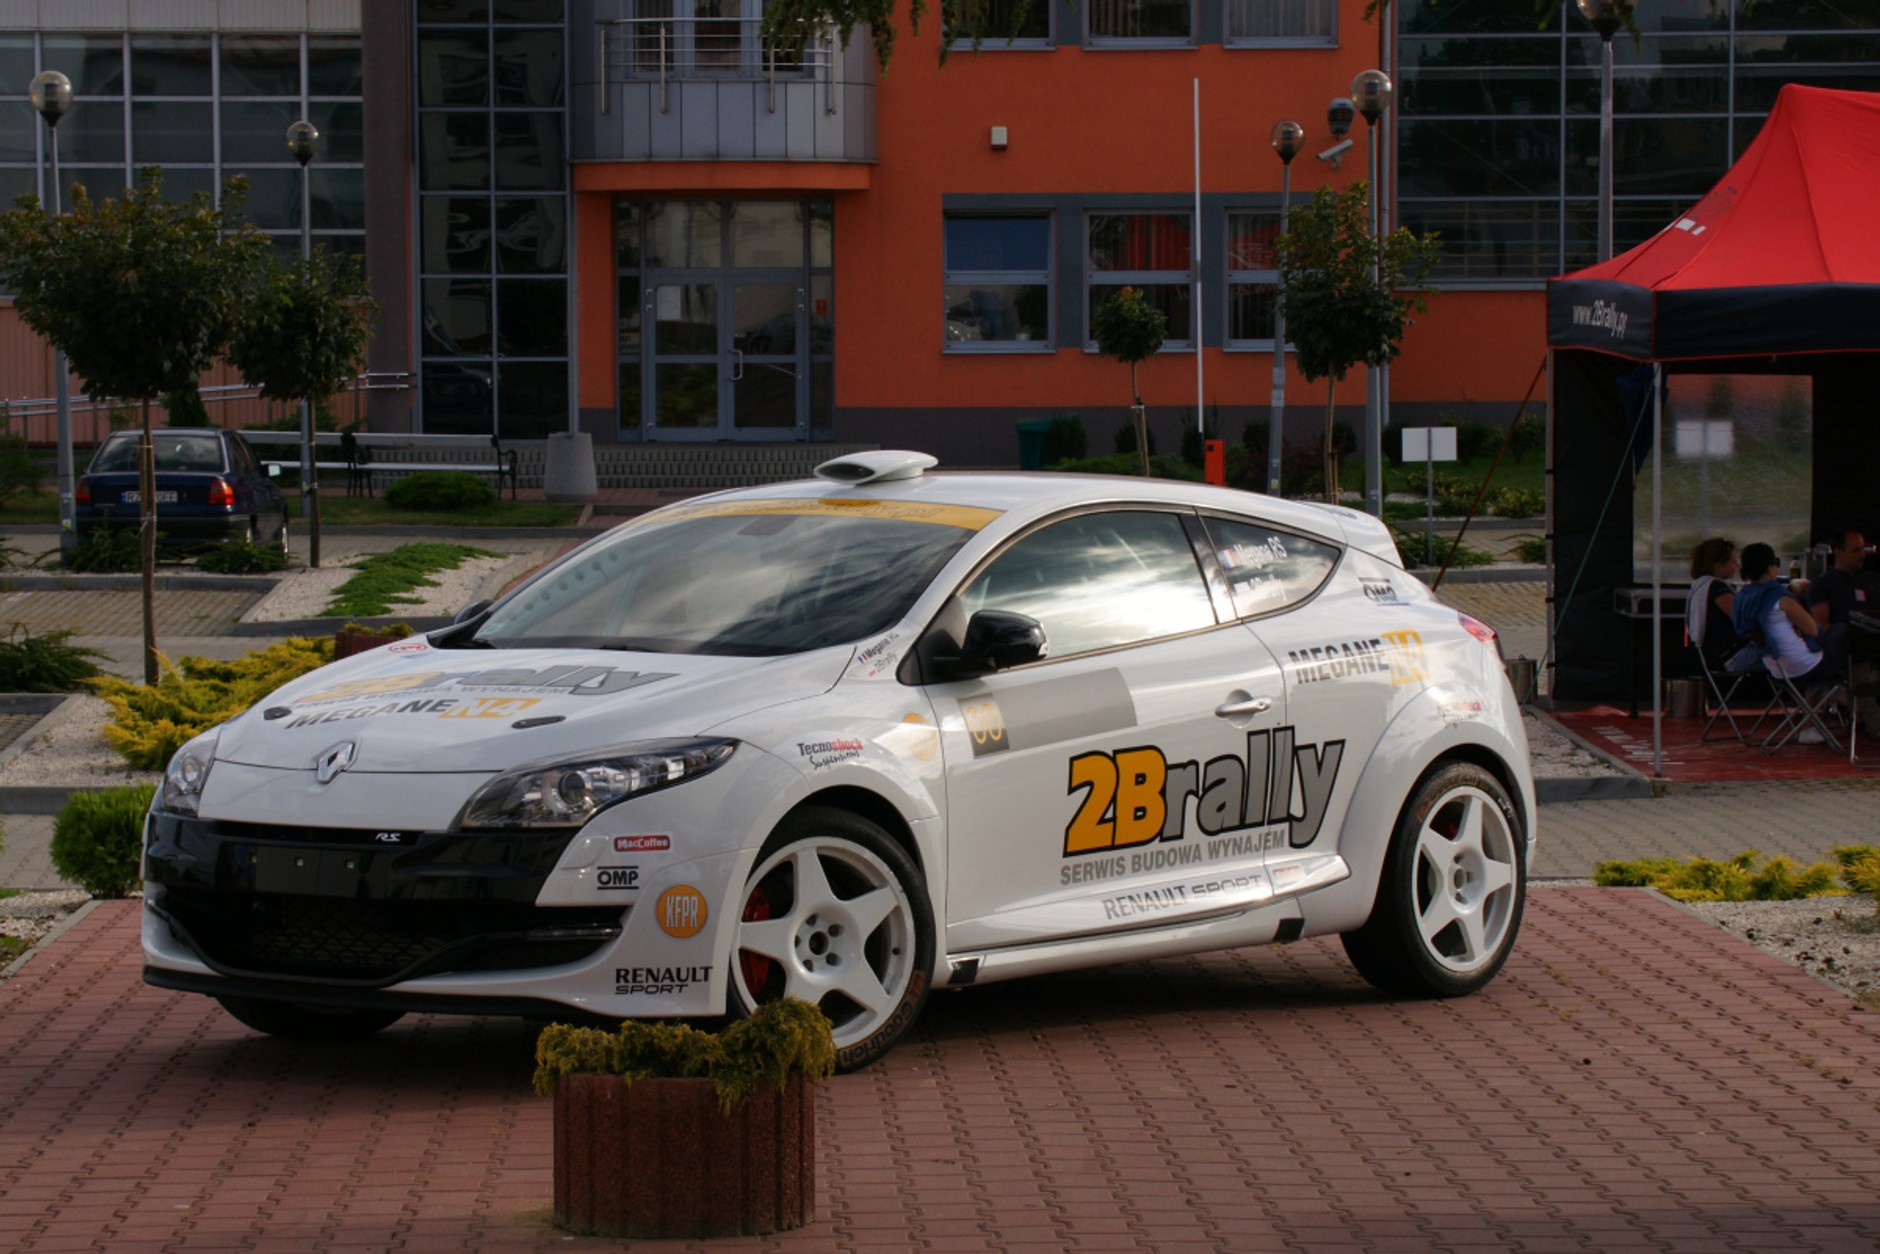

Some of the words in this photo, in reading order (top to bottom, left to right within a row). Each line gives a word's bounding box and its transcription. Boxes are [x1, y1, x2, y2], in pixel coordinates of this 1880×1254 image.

[1288, 638, 1390, 684] MEGANE
[284, 699, 459, 729] MEGANE
[796, 736, 865, 757] Tecnoshock
[1062, 725, 1346, 858] 2Brally
[617, 837, 669, 850] MacCoffee
[1060, 852, 1126, 885] SERWIS
[1131, 841, 1202, 874] BUDOWA
[1207, 829, 1285, 860] WYNAJEM
[597, 870, 639, 886] OMP
[1102, 885, 1188, 920] RENAULT
[1191, 873, 1263, 898] SPORT
[665, 895, 699, 929] KFPR
[614, 984, 689, 995] SPORT
[615, 966, 714, 984] RENAULT
